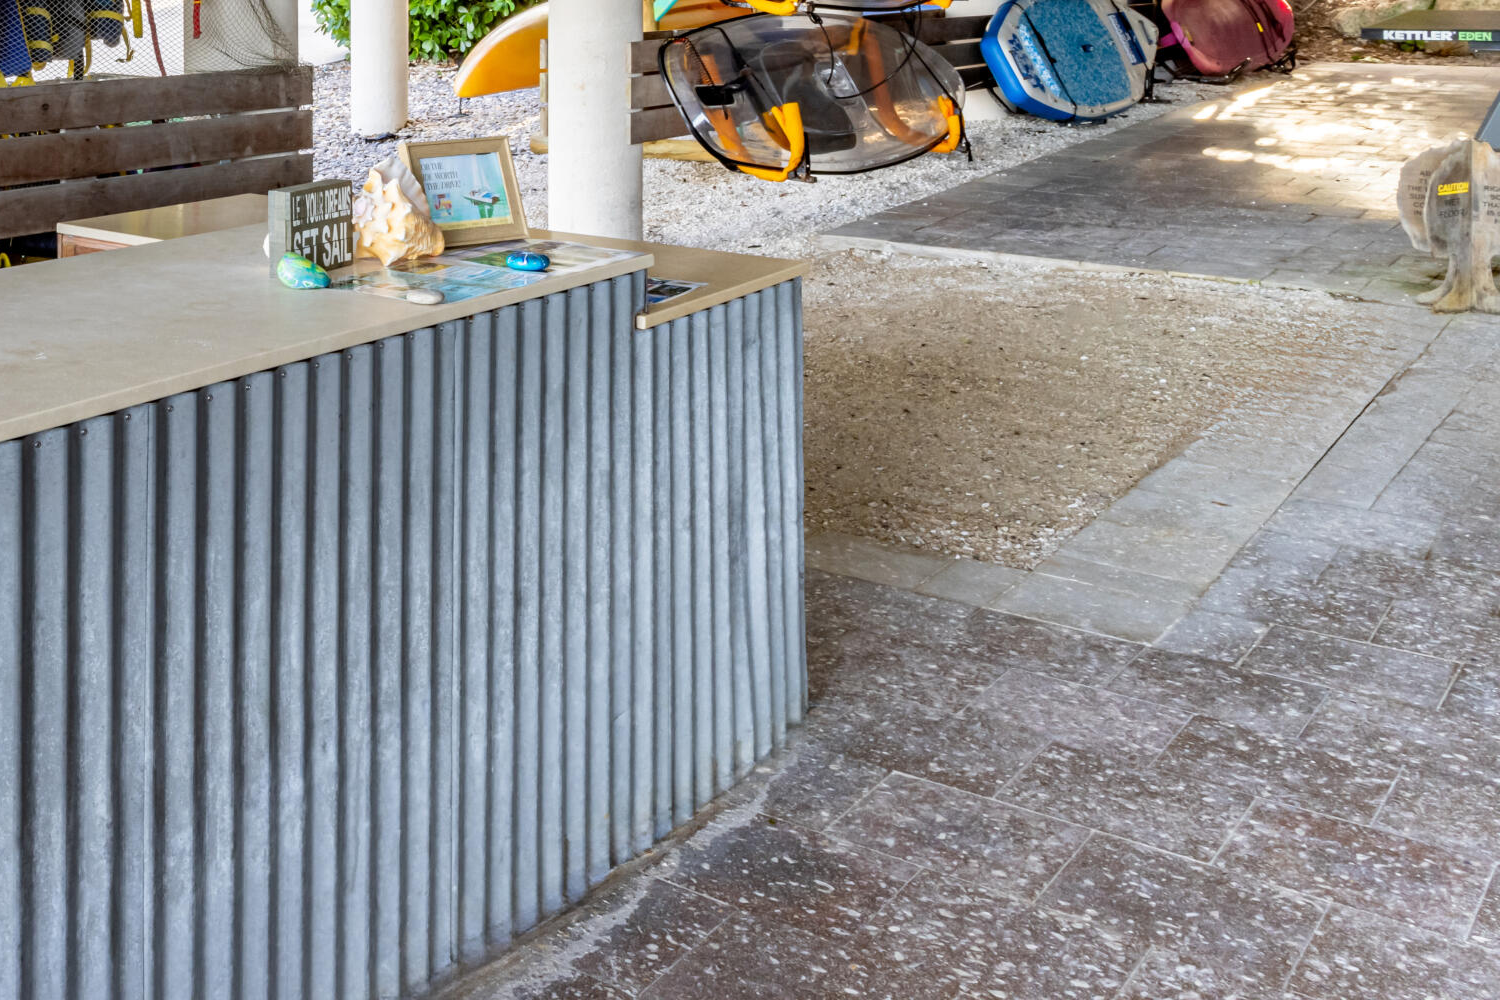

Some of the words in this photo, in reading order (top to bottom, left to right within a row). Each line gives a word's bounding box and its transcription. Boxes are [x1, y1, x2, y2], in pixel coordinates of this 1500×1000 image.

[1382, 30, 1453, 41] KETTLER
[1458, 31, 1492, 41] EDEN
[1438, 182, 1469, 193] CAUTION
[305, 191, 324, 224] YOUR
[324, 185, 351, 219] DREAMS
[294, 228, 319, 264] SET
[322, 222, 352, 267] SAIL
